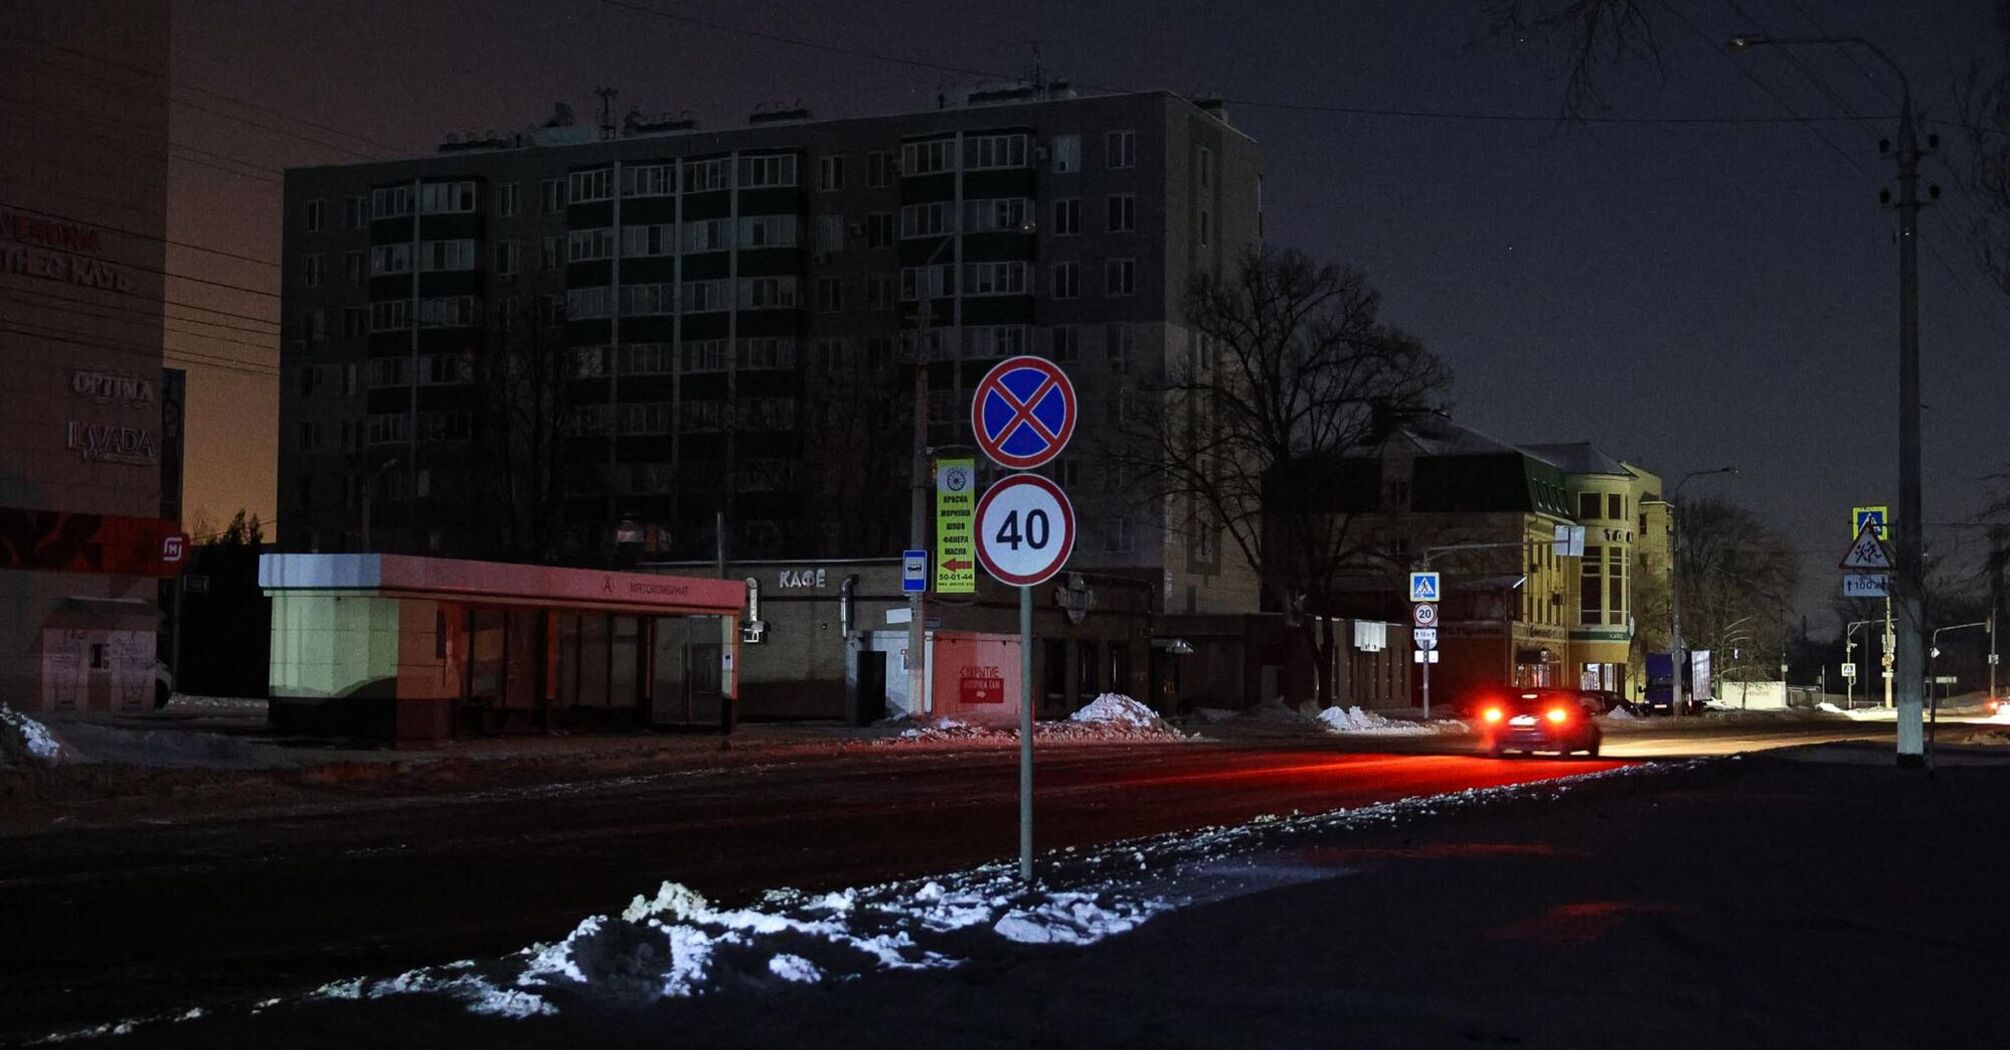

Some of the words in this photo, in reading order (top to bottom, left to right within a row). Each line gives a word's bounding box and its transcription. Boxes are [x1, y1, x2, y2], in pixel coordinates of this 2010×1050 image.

[996, 509, 1049, 550] 40
[779, 568, 826, 588] КАФЕ
[938, 573, 974, 581] 50-01-44
[1855, 581, 1872, 589] 100
[1419, 610, 1431, 618] 20
